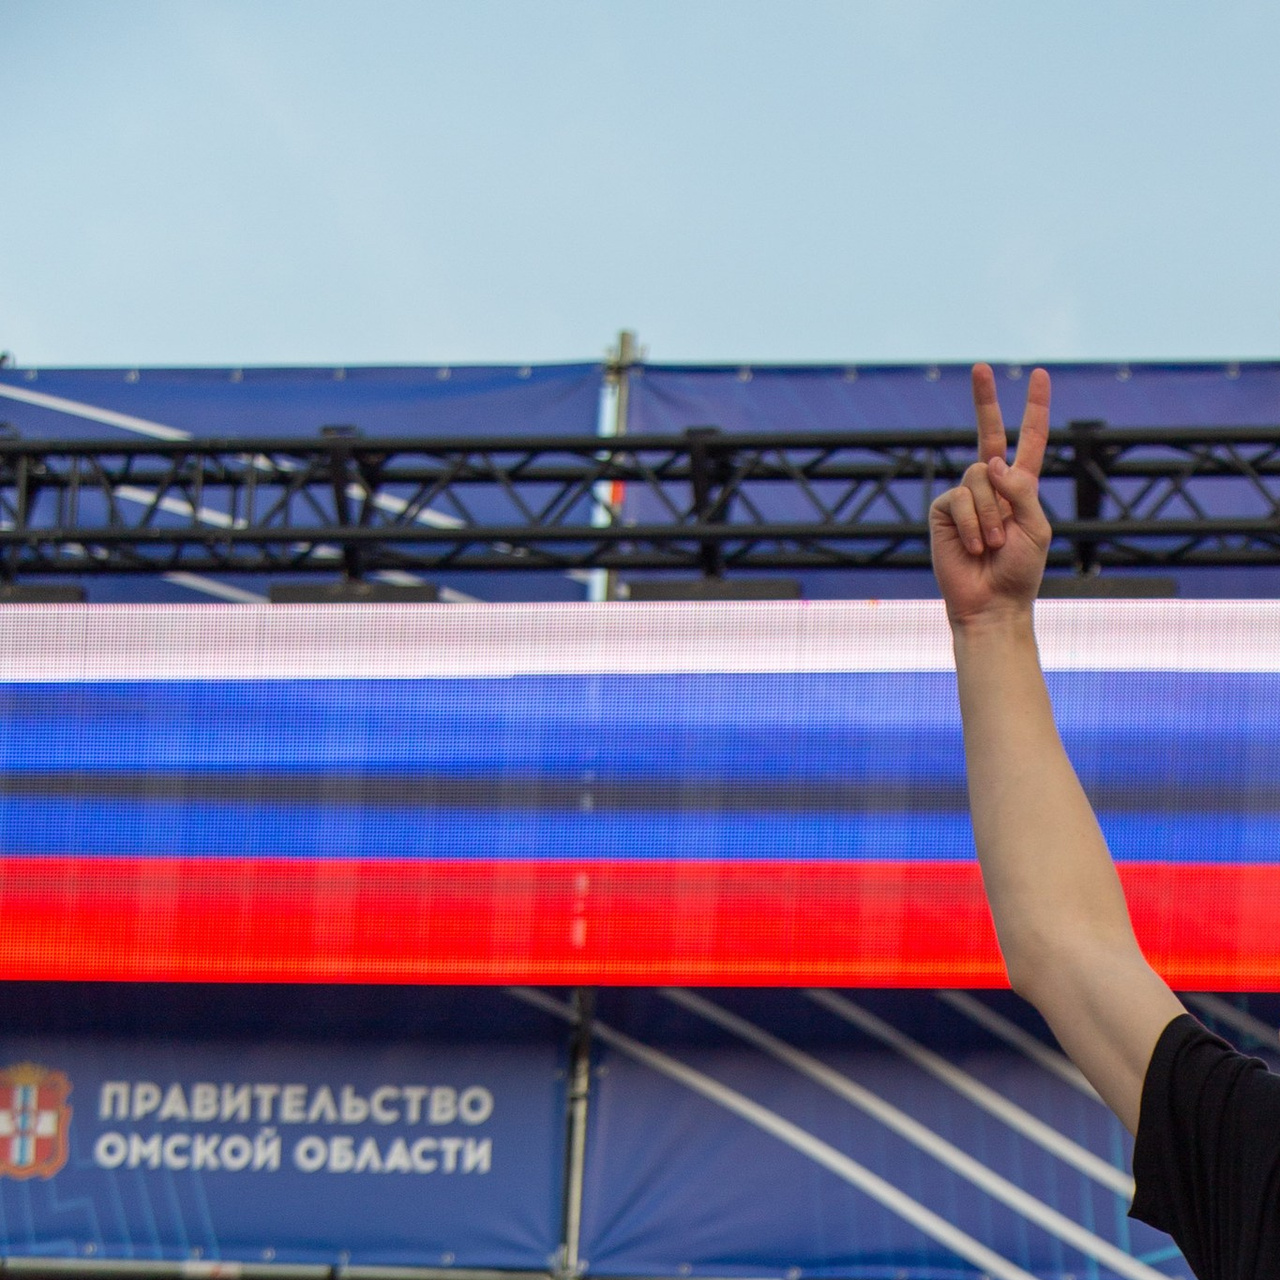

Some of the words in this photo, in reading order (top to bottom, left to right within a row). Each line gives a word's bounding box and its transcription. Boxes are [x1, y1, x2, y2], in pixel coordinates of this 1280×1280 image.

[101, 1081, 494, 1125] ПРАВИТЕЛЬСТВО
[95, 1128, 282, 1171] ОМСКОЙ
[293, 1136, 493, 1175] ОБЛАСТИ
